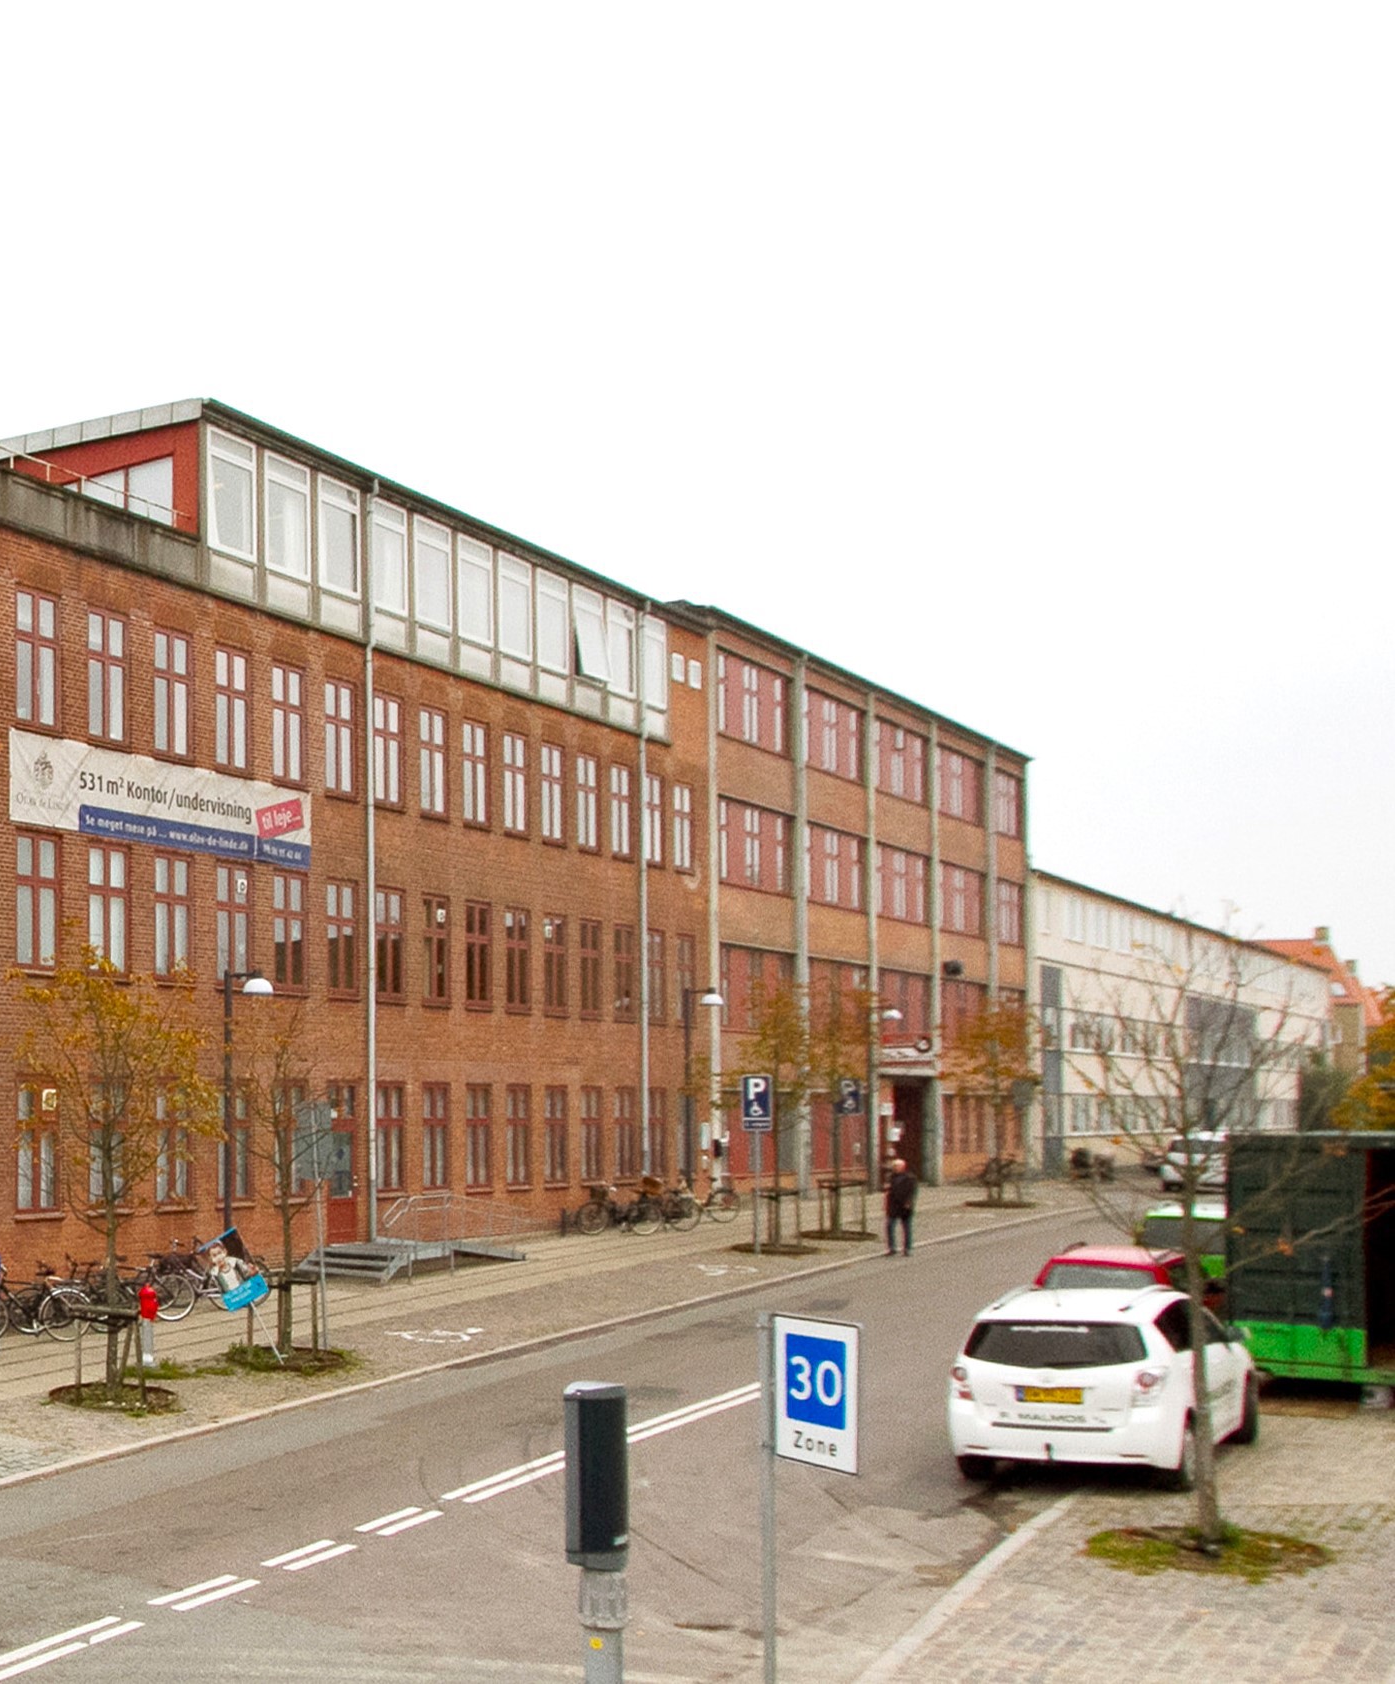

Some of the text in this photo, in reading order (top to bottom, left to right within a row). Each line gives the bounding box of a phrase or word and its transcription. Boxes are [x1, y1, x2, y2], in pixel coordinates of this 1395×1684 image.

[79, 771, 103, 793] 531
[85, 814, 96, 826] Se
[97, 818, 123, 832] meget
[125, 823, 145, 834] mere
[262, 811, 273, 831] til
[748, 1078, 765, 1099] P
[790, 1355, 842, 1407] 30
[793, 1430, 838, 1457] Zone
